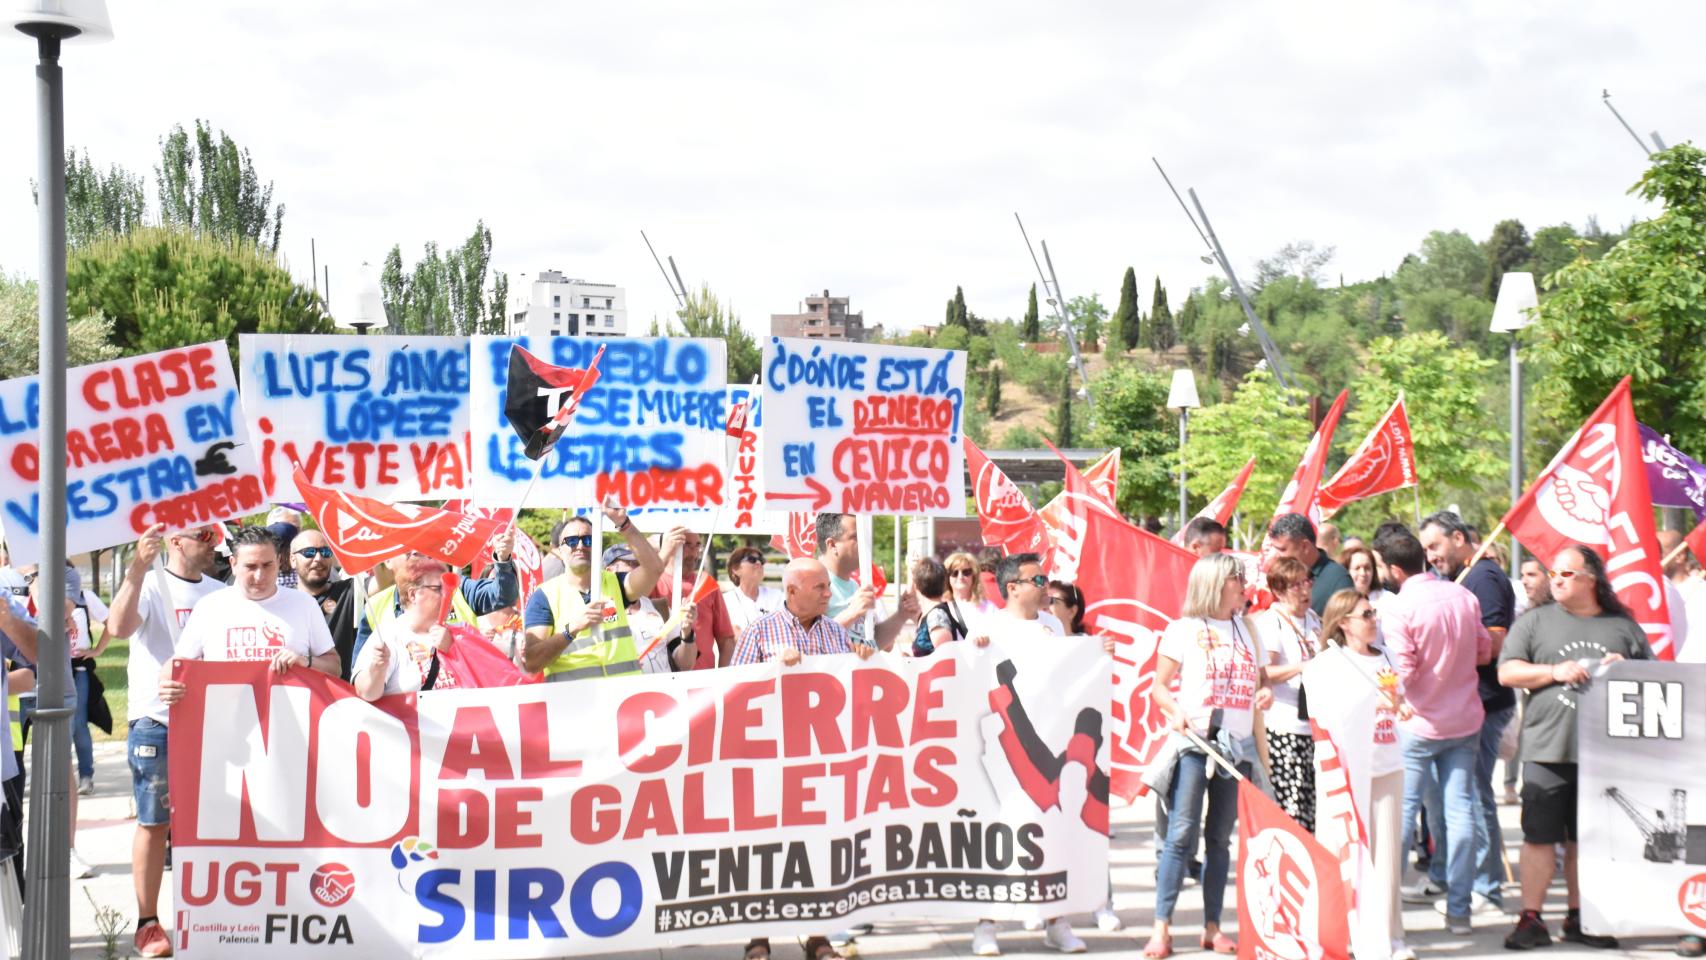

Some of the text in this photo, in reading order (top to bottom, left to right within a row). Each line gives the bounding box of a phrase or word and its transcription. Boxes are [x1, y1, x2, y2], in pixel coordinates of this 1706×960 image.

[82, 347, 217, 412] CLASE
[264, 349, 371, 397] LUIS
[768, 336, 955, 395] ¿DÓNDE ESTÁ
[325, 390, 460, 441] LÓPEZ
[575, 388, 632, 427] SE
[637, 388, 727, 431] MUERE
[807, 396, 843, 428] EL
[11, 389, 237, 481] ORERA EN
[488, 432, 684, 481] LE DEJAIS
[783, 437, 949, 483] EN CEVICO
[5, 455, 198, 534] VESTRA
[596, 463, 723, 507] MORIR
[842, 481, 950, 514] NAVERO
[226, 649, 240, 658] AL
[1608, 680, 1683, 738] EN
[196, 658, 957, 844] NO AL CIERRE
[437, 745, 958, 849] DE GALLETAS
[651, 808, 1044, 901] VENTA DE BAÑOS
[181, 861, 299, 907] UGT
[414, 861, 643, 943] SIRO
[657, 877, 1067, 931] #NoAlCierreDeGalletasSiro
[192, 923, 260, 934] Castilla y León
[219, 935, 260, 944] Palencia
[265, 914, 354, 944] FICA
